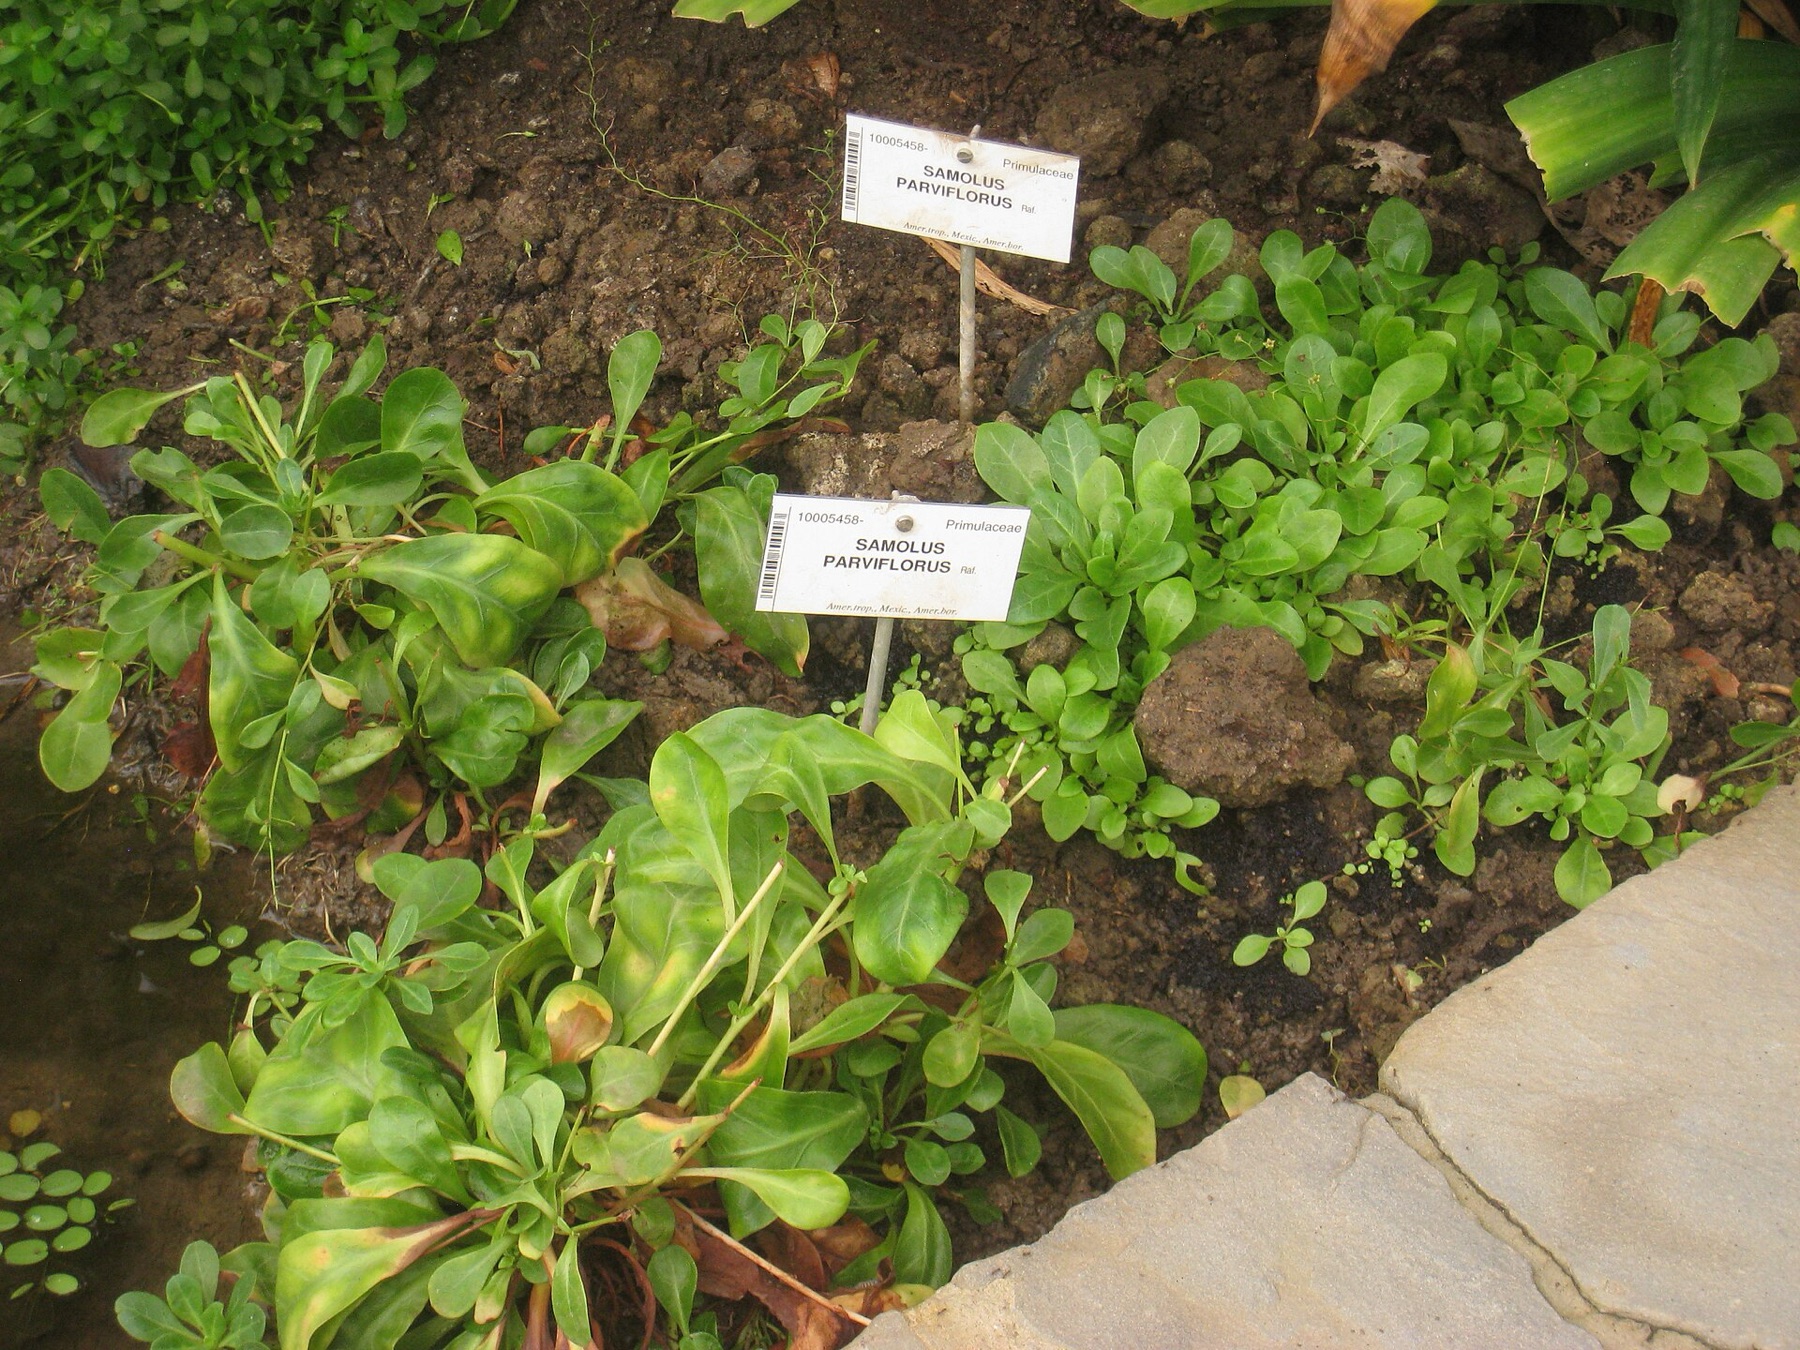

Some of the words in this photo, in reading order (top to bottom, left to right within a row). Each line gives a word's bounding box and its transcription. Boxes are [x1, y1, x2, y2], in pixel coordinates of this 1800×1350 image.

[869, 133, 928, 152] 10005458-
[924, 165, 1005, 190] SAMOLUS
[1003, 159, 1074, 180] Primulaceae
[897, 177, 1012, 209] PARVIFLORUS
[1022, 205, 1036, 214] Raf.
[798, 512, 864, 525] 10005458-
[946, 520, 1022, 533] Primulaceae
[856, 538, 945, 554] SAMOLUS
[823, 556, 951, 573] PARVIFLORUS
[961, 566, 976, 575] Raf.
